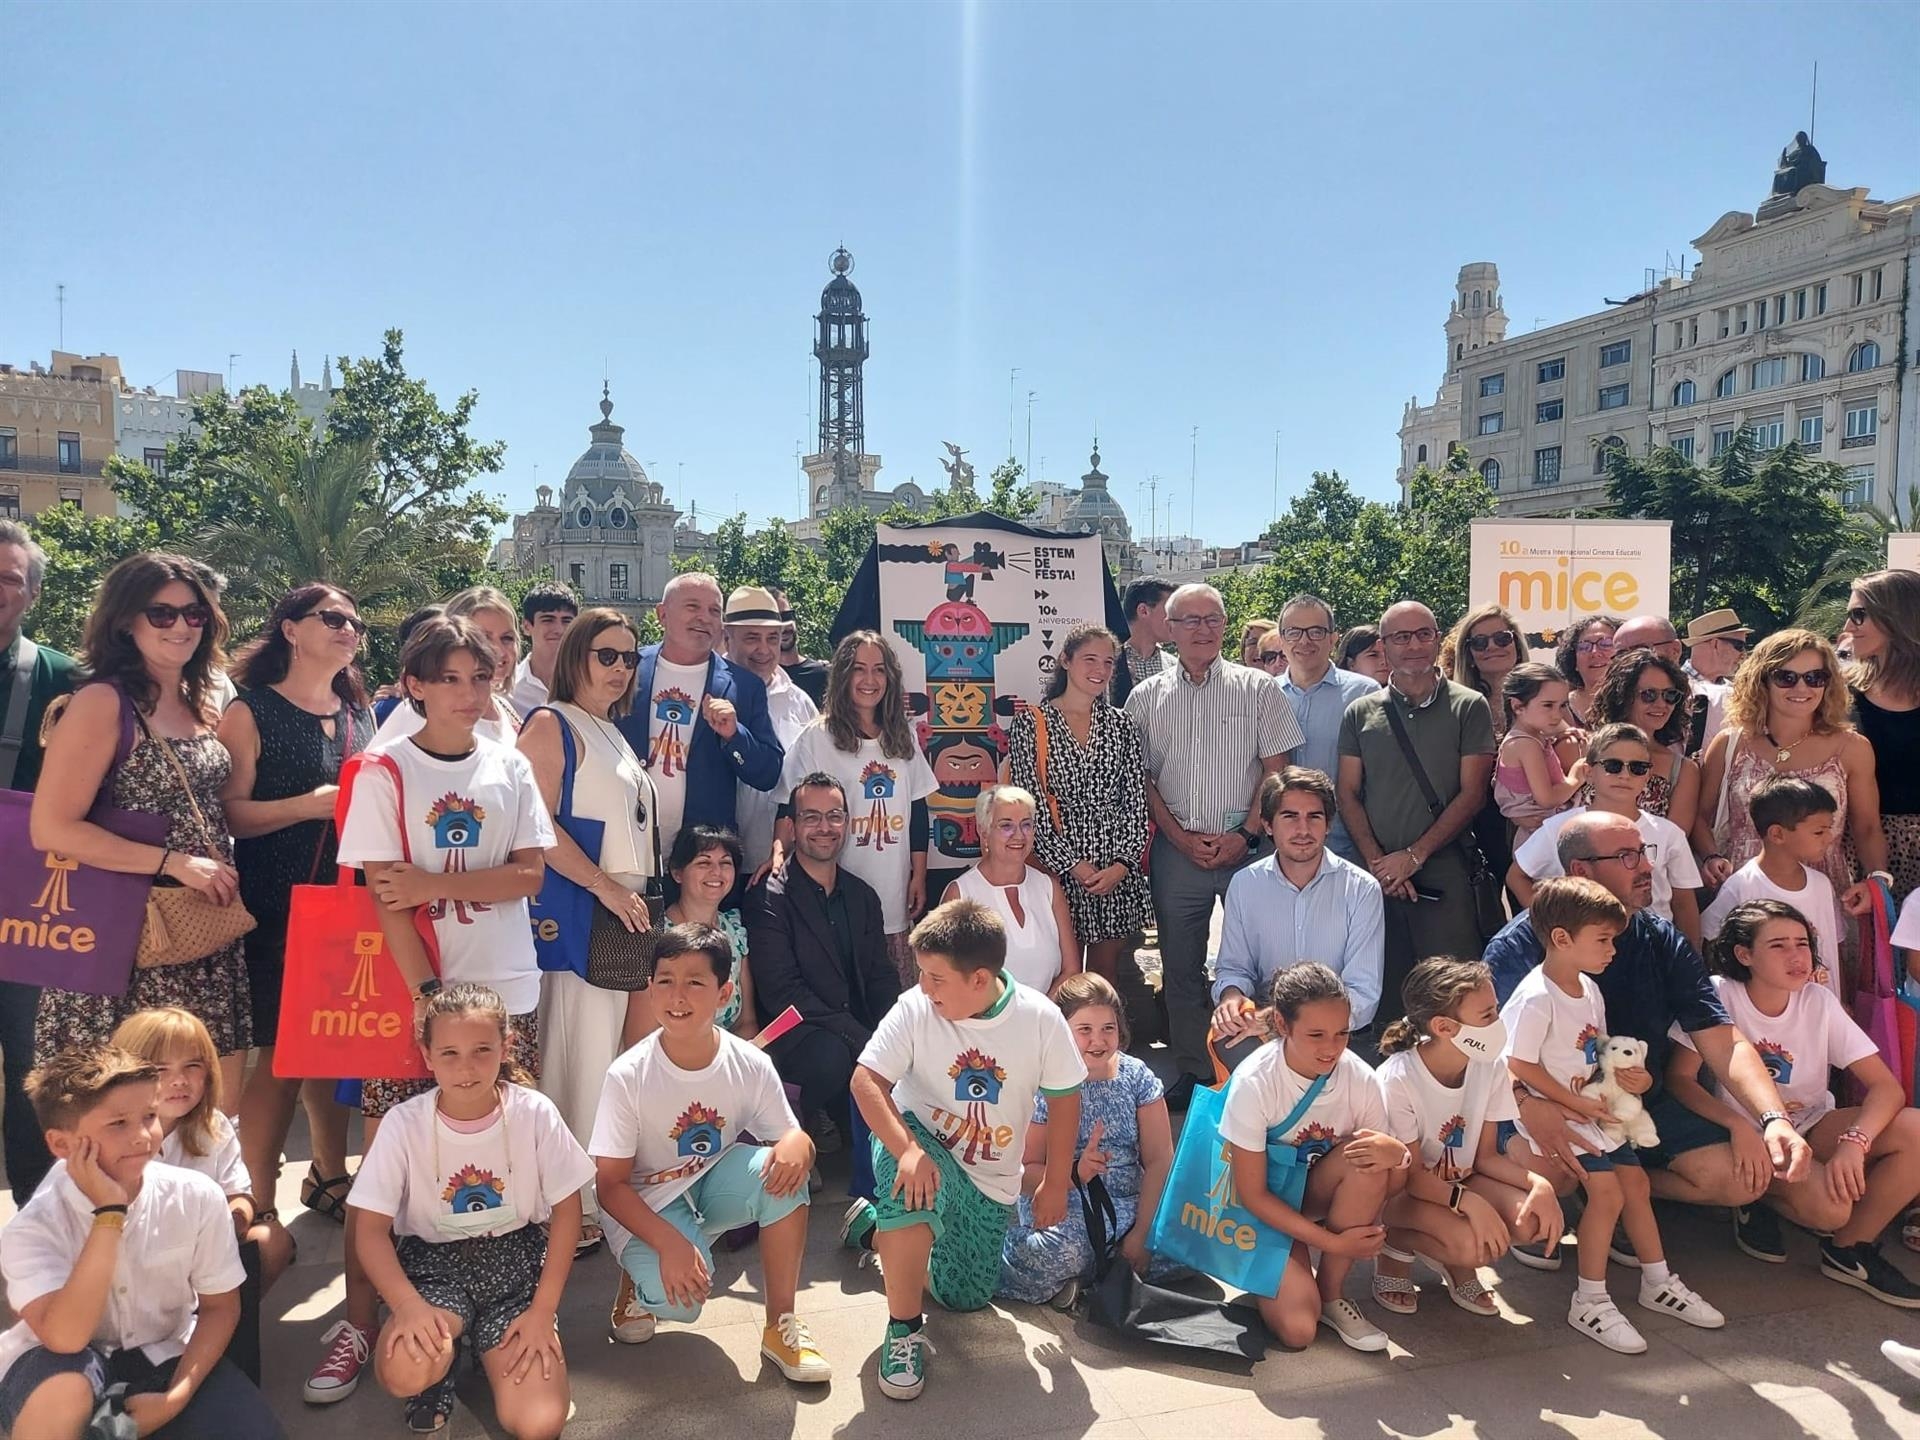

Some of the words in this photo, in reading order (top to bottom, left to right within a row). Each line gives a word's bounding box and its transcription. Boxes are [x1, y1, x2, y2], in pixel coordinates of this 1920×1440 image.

[1034, 547, 1075, 559] ESTEM
[1034, 558, 1050, 569] DE
[1035, 569, 1076, 581] FESTA!
[1500, 557, 1640, 612] mice
[1040, 659, 1056, 670] 26
[0, 913, 96, 953] mice
[310, 1001, 402, 1038] mice
[1462, 1037, 1488, 1052] FULL
[1181, 1202, 1257, 1251] mice
